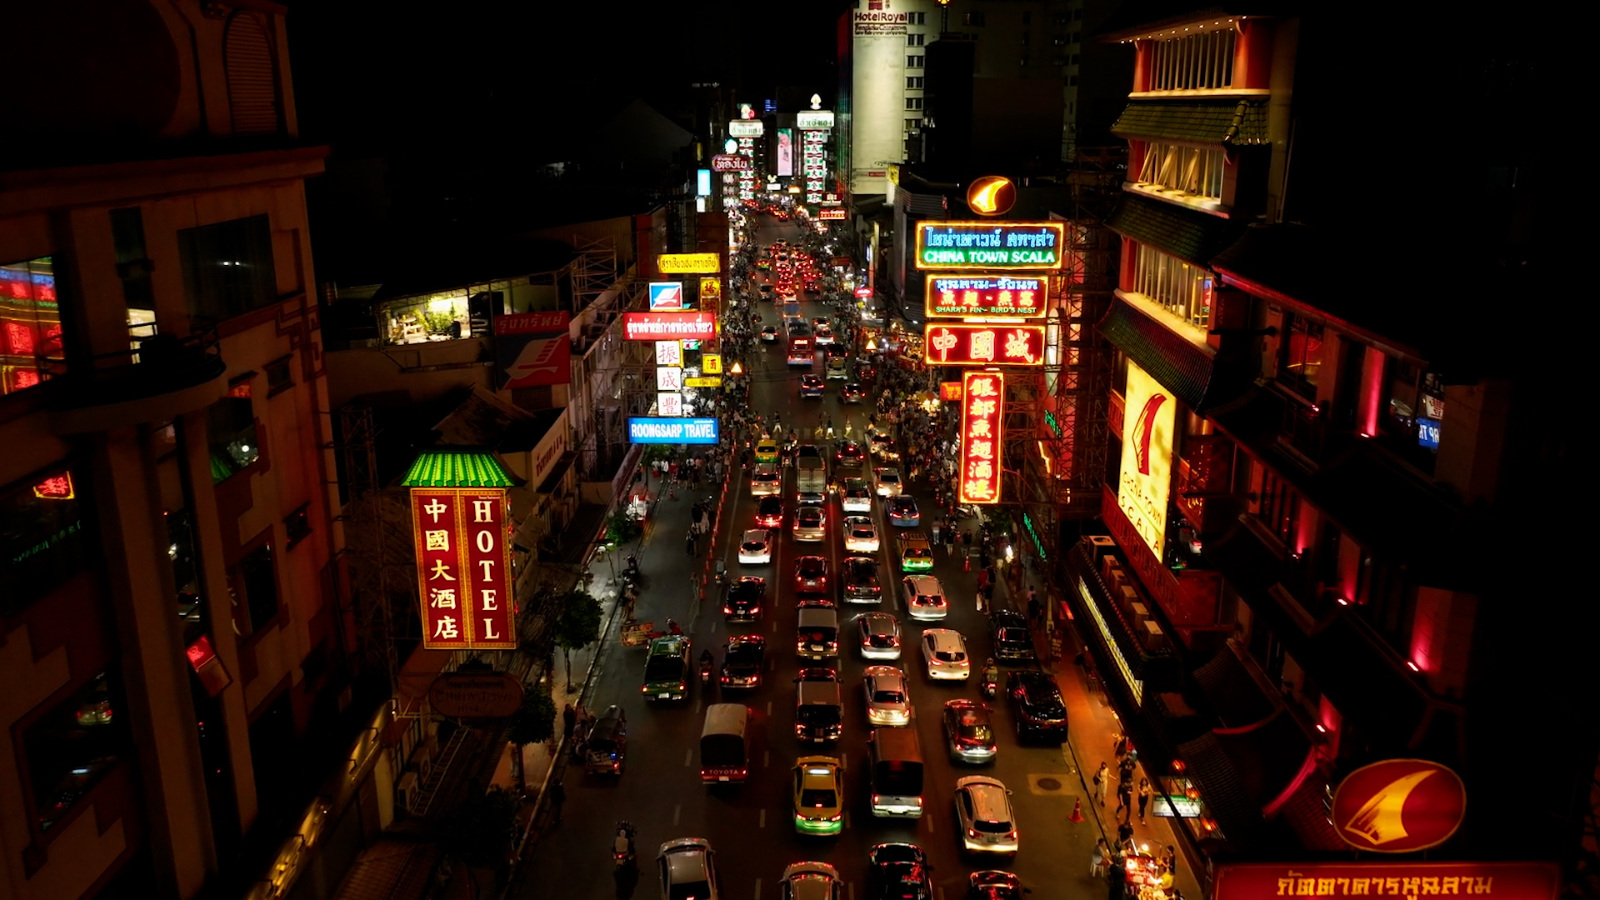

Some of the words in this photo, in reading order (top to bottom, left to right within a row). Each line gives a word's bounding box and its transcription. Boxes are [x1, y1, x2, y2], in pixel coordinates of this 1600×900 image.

[925, 226, 1001, 246] ไชน่าทาวน์
[1007, 228, 1055, 247] สกาล่า
[924, 251, 965, 263] CHINA
[969, 251, 1008, 263] TOWN
[1011, 251, 1055, 263] SCALA
[932, 328, 1034, 363] 中國城
[631, 423, 682, 437] ROONGSARP
[684, 423, 716, 438] TRAVEL
[1121, 495, 1159, 552] SCALA
[1144, 496, 1162, 526] TOWN
[424, 498, 458, 639] 中國大酒店
[472, 500, 499, 640] HOTEL
